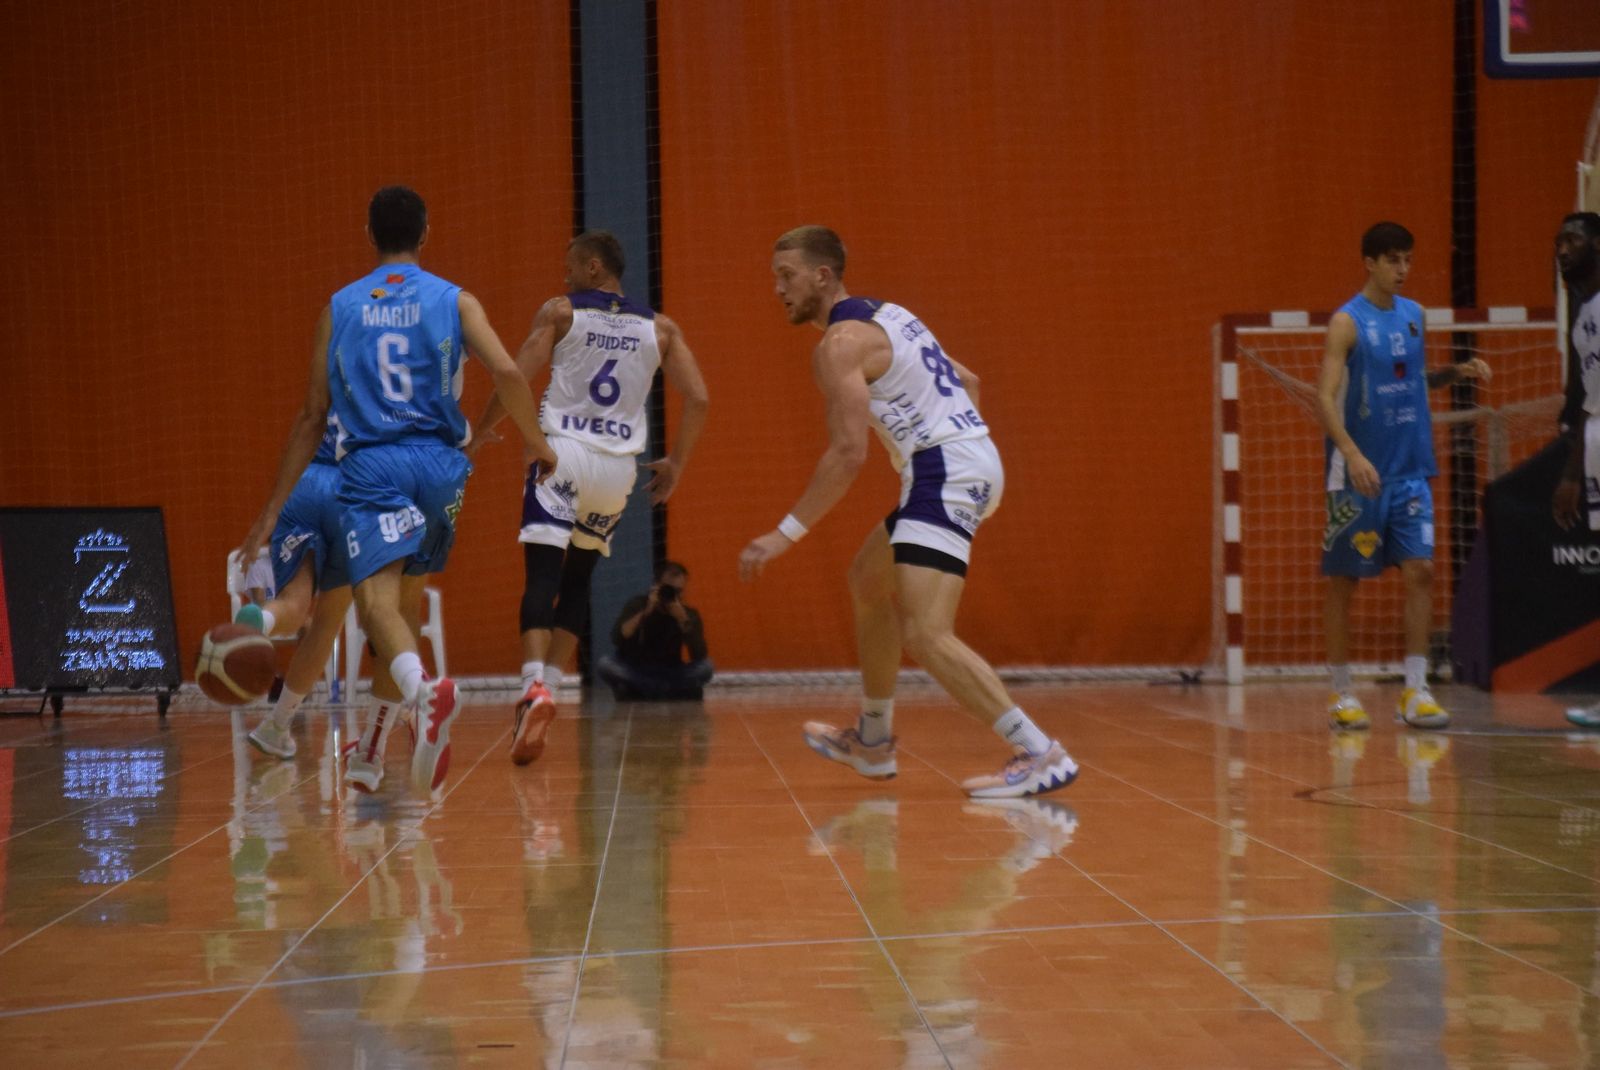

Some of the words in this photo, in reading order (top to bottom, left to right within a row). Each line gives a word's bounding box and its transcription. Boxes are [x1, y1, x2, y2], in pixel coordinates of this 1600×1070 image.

[585, 332, 640, 352] PUIDET
[377, 332, 413, 403] 6
[589, 359, 621, 407] 6
[561, 414, 632, 441] IVECO
[346, 530, 360, 559] 6
